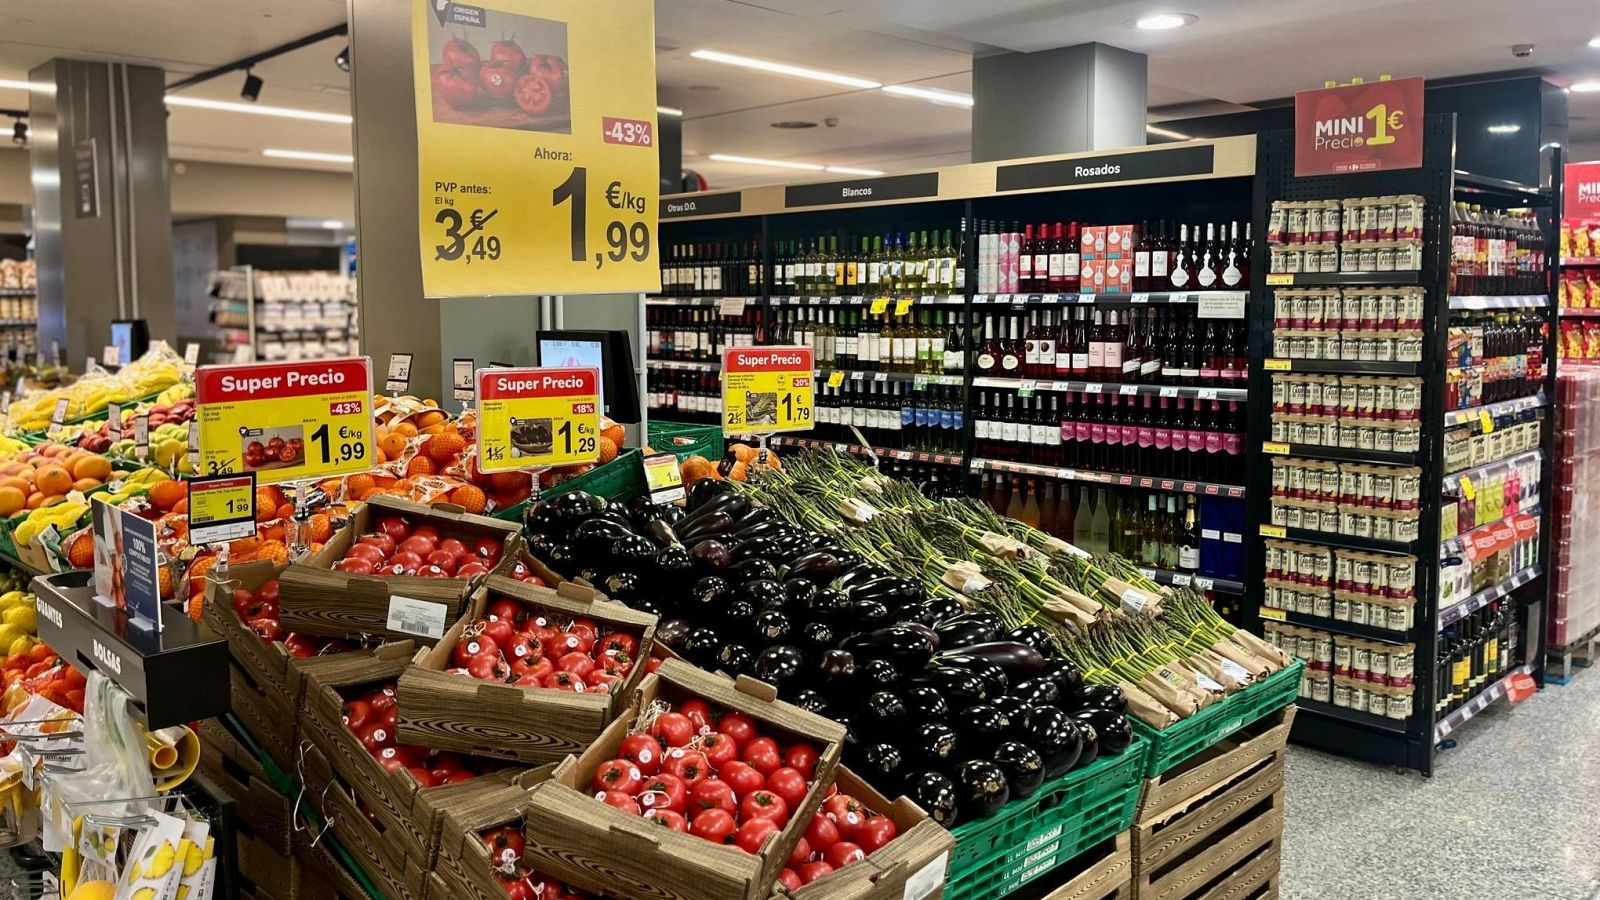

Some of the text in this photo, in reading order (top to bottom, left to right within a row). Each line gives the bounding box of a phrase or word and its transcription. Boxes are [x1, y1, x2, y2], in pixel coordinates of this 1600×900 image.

[605, 121, 650, 144] -43%
[1315, 116, 1363, 136] MINI
[1315, 135, 1364, 150] Precio
[534, 147, 572, 161] Ahora:
[1074, 162, 1121, 178] Rosados
[435, 182, 492, 195] PVP antes:
[842, 186, 872, 198] Blancos
[435, 197, 454, 207] El kg
[605, 181, 646, 213] €/kg
[667, 202, 697, 213] Otras D.O.
[738, 353, 802, 368] Super Precio
[221, 368, 345, 393] Super Precio
[497, 375, 584, 393] Super Precio
[793, 379, 809, 387] -20%
[331, 402, 361, 414] -43%
[574, 404, 593, 413] -18%
[339, 426, 362, 440] €/kg
[577, 423, 594, 435] €/kg
[36, 597, 63, 629] GUANTES
[93, 639, 121, 675] BOLSAS
